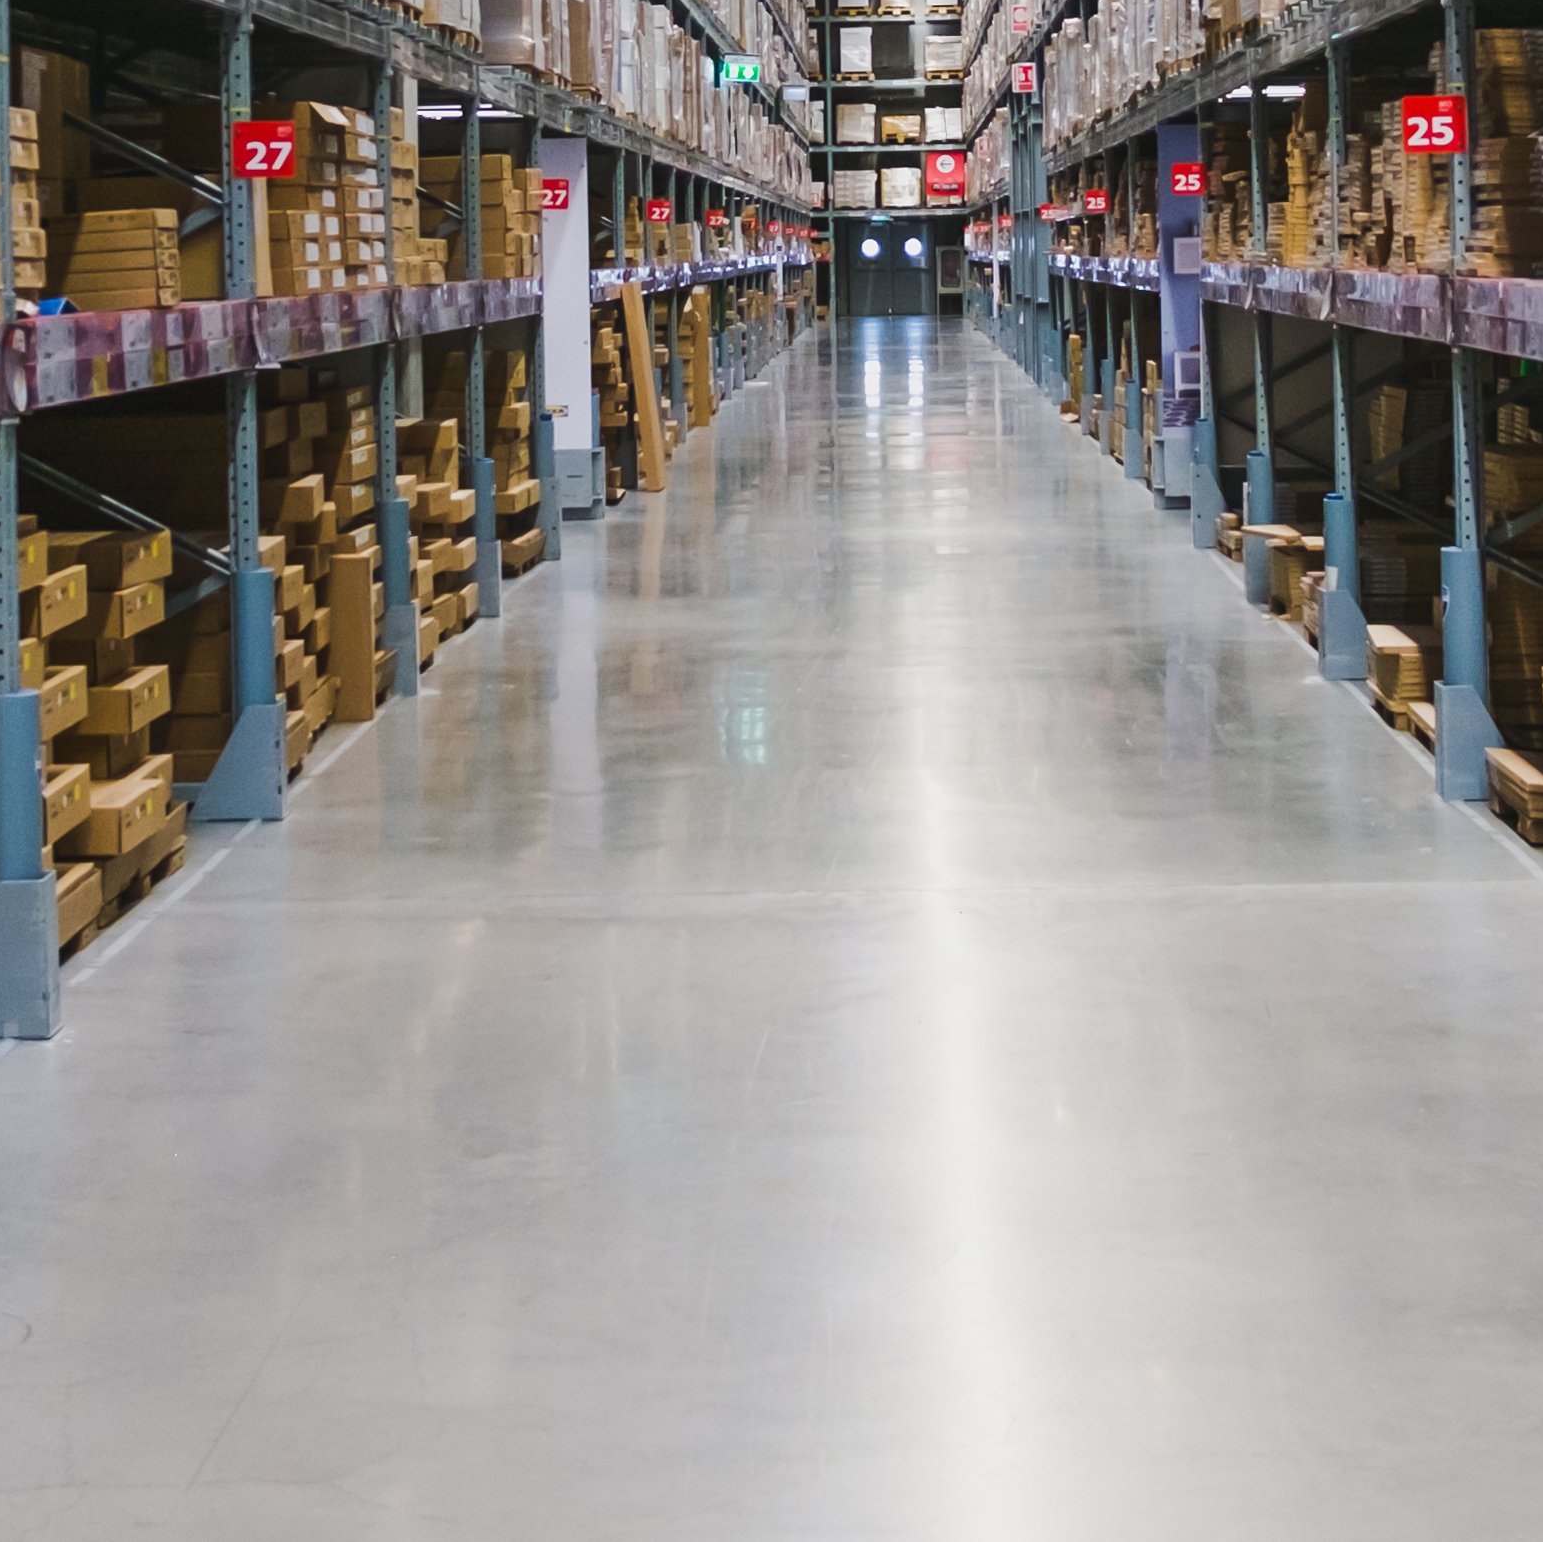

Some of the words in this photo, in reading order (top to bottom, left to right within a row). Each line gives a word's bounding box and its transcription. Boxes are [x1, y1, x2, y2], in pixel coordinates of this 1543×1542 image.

[1407, 116, 1454, 147] 25
[245, 141, 292, 170] 27
[1174, 173, 1201, 191] 25
[542, 189, 567, 206] 27
[1086, 197, 1106, 209] 25
[651, 207, 670, 220] 27
[709, 216, 723, 225] 27
